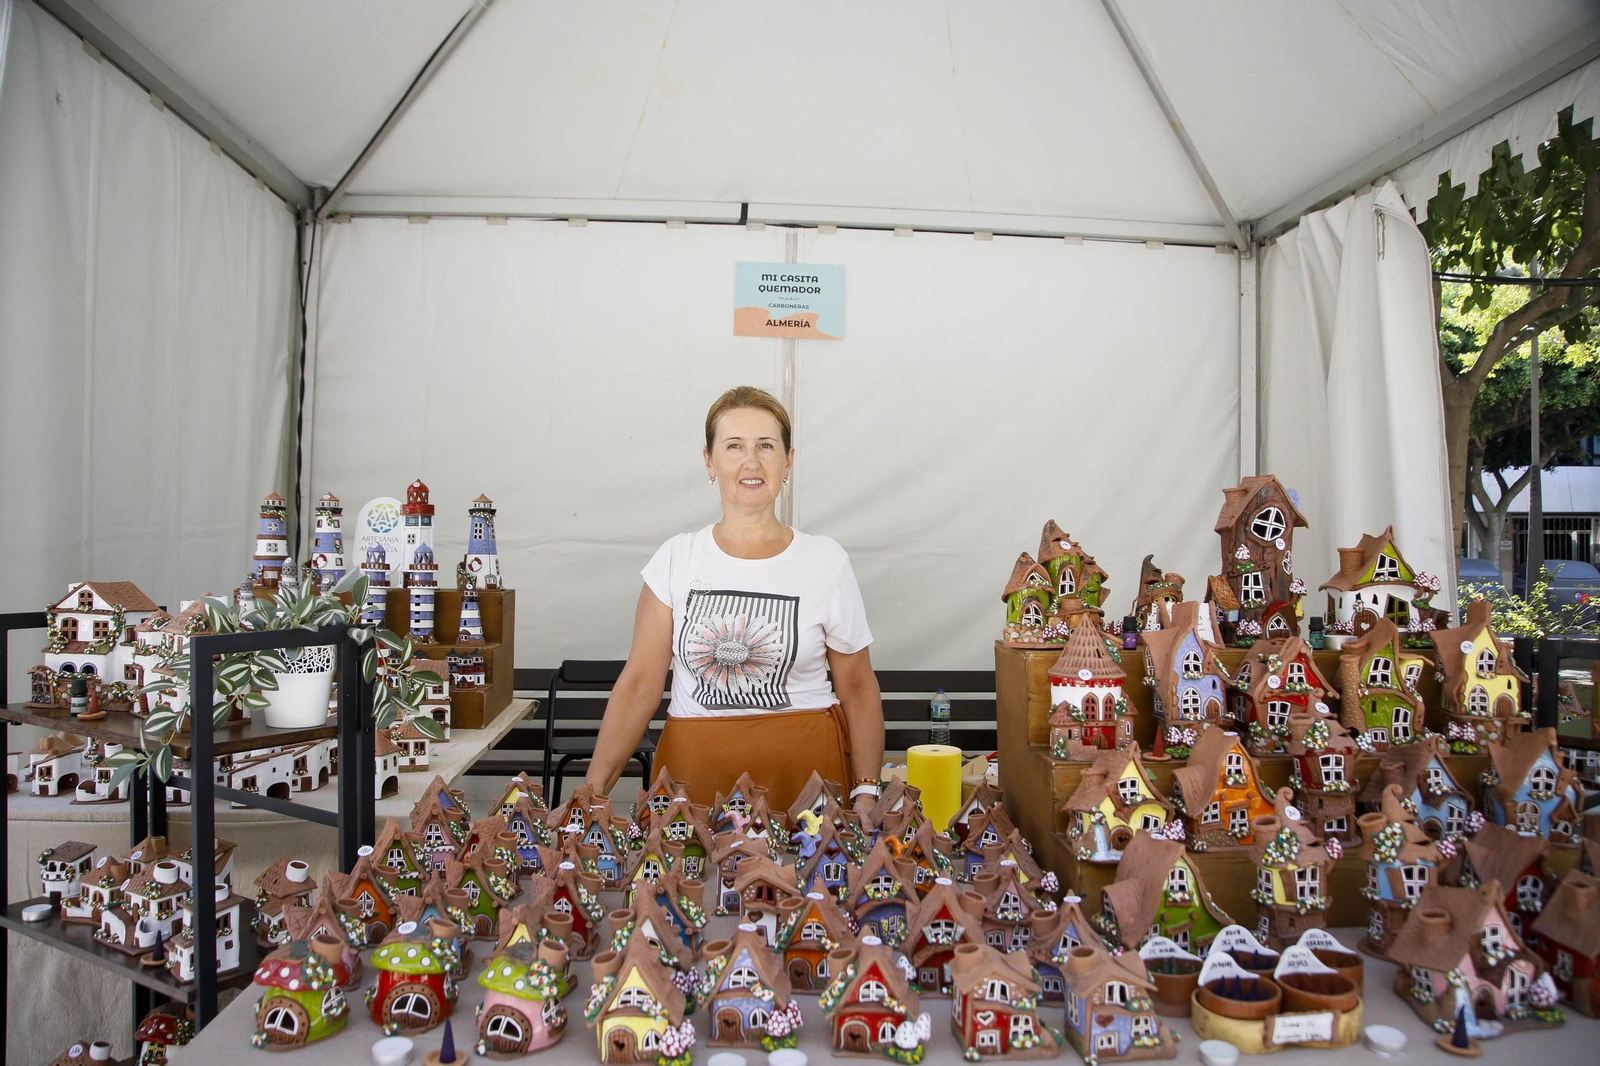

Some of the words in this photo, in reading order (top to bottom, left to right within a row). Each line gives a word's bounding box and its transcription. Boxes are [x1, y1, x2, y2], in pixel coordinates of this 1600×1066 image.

[761, 273, 778, 282] MI
[780, 274, 819, 283] CASITA
[758, 284, 821, 294] QUEMADOR
[765, 319, 811, 328] ALMERÍA
[361, 535, 399, 543] ARTESANÍA
